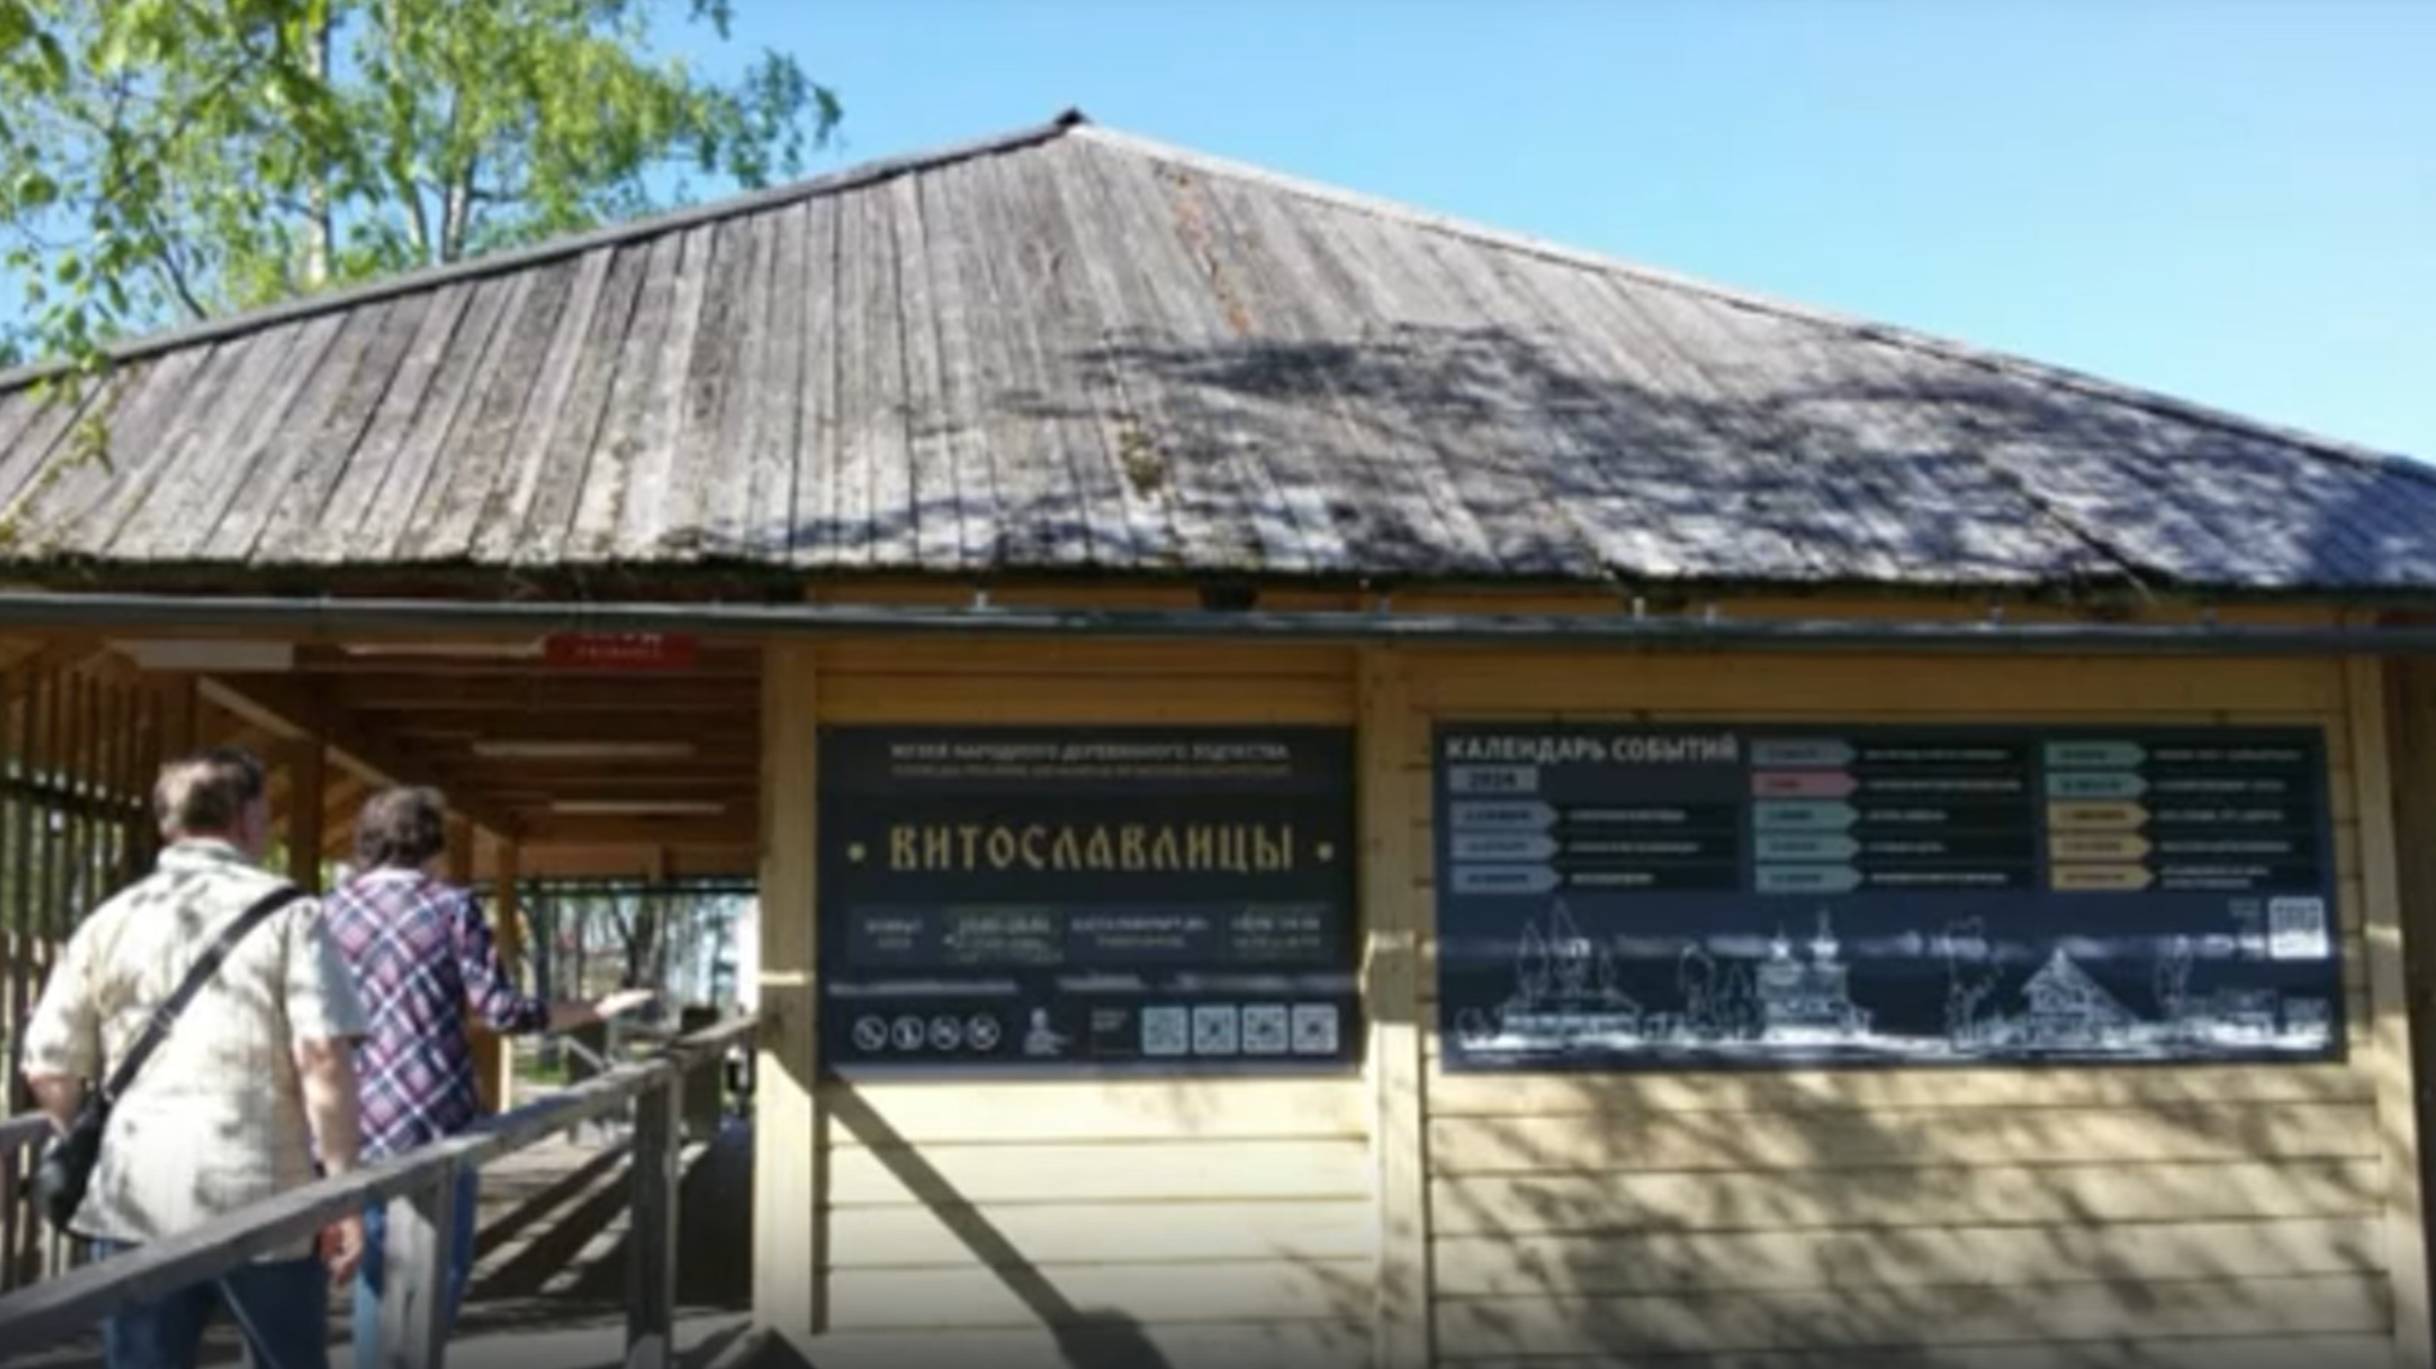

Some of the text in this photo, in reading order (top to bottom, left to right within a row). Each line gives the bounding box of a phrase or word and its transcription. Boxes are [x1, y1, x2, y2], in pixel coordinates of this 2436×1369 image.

[1445, 733, 1739, 762] КАЛЕНДАРЬ СОБЫТИЙ
[887, 823, 1294, 874] ВИТОСЛАВЛИЦЫ
